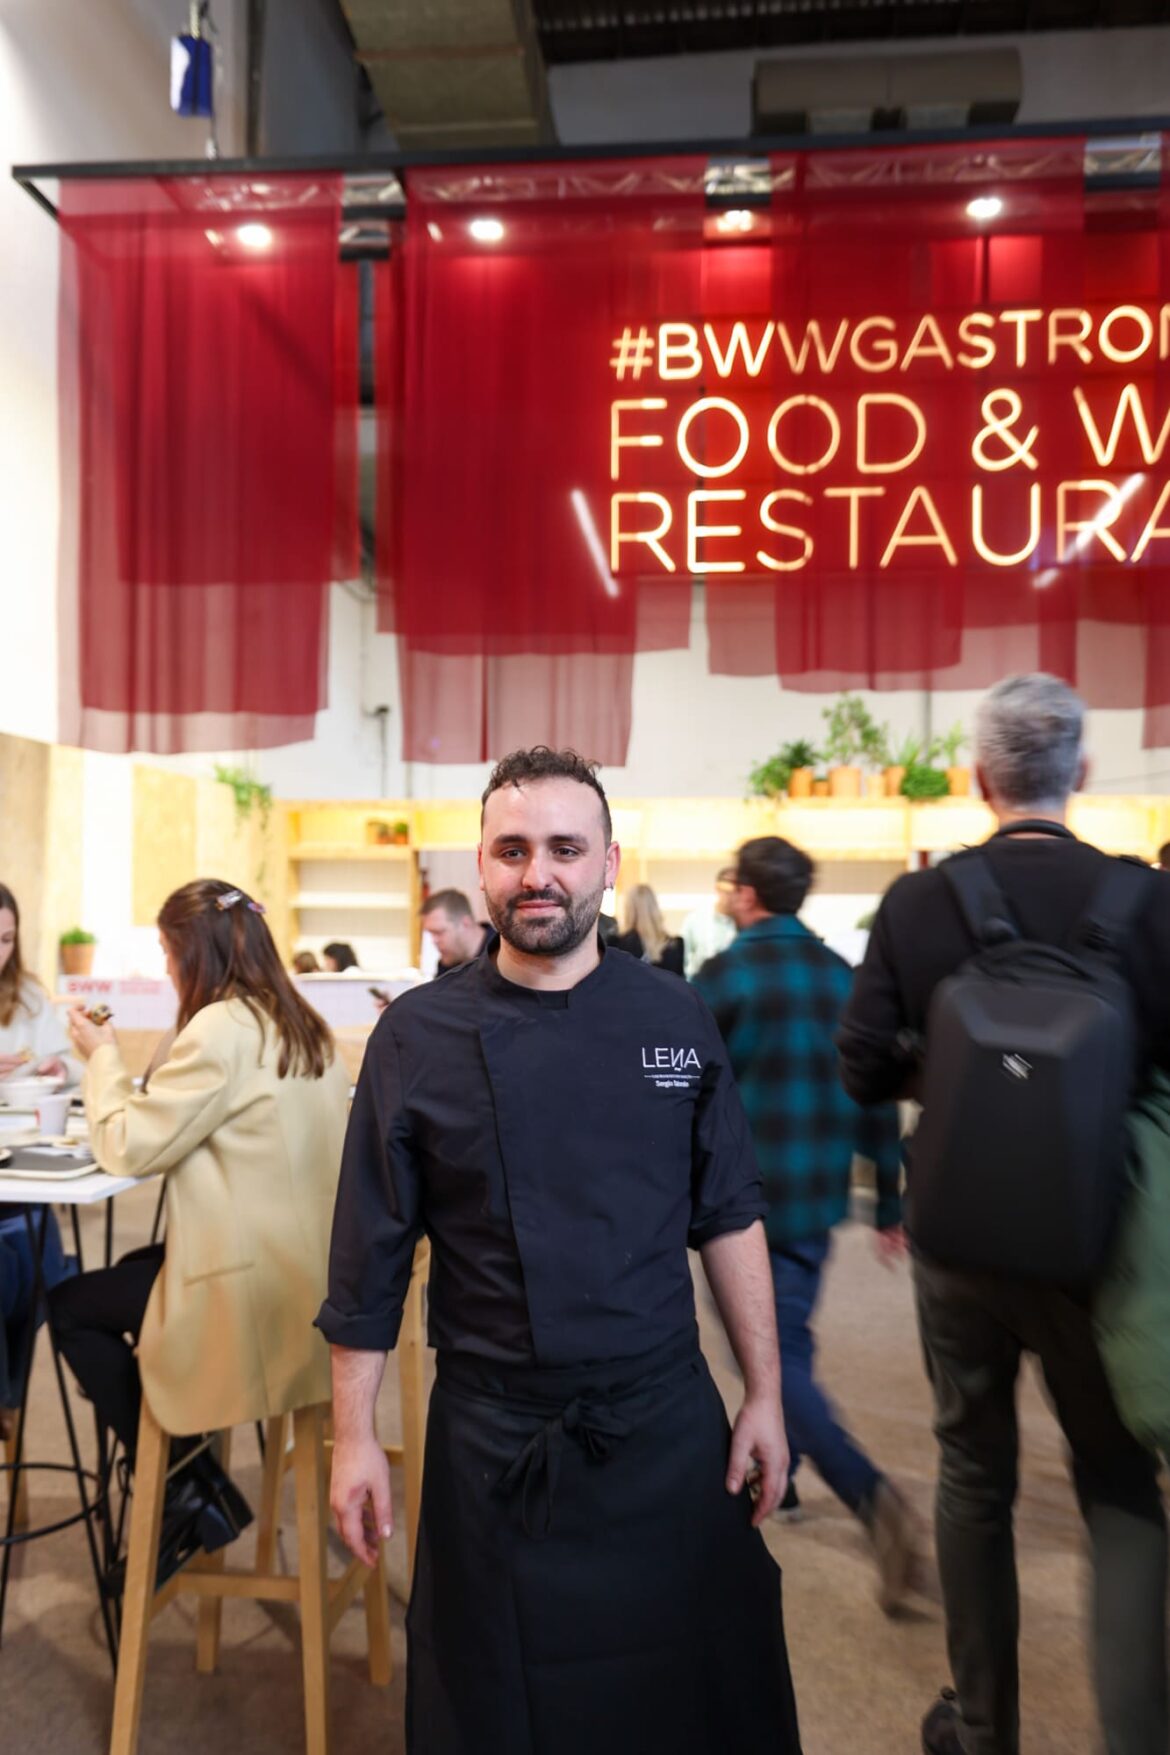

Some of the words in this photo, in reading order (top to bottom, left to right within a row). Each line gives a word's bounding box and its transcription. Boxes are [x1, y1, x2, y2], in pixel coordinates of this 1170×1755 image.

[609, 304, 1170, 381] #BWWGASTRO
[610, 393, 927, 480] FOOD
[971, 386, 1040, 471] &
